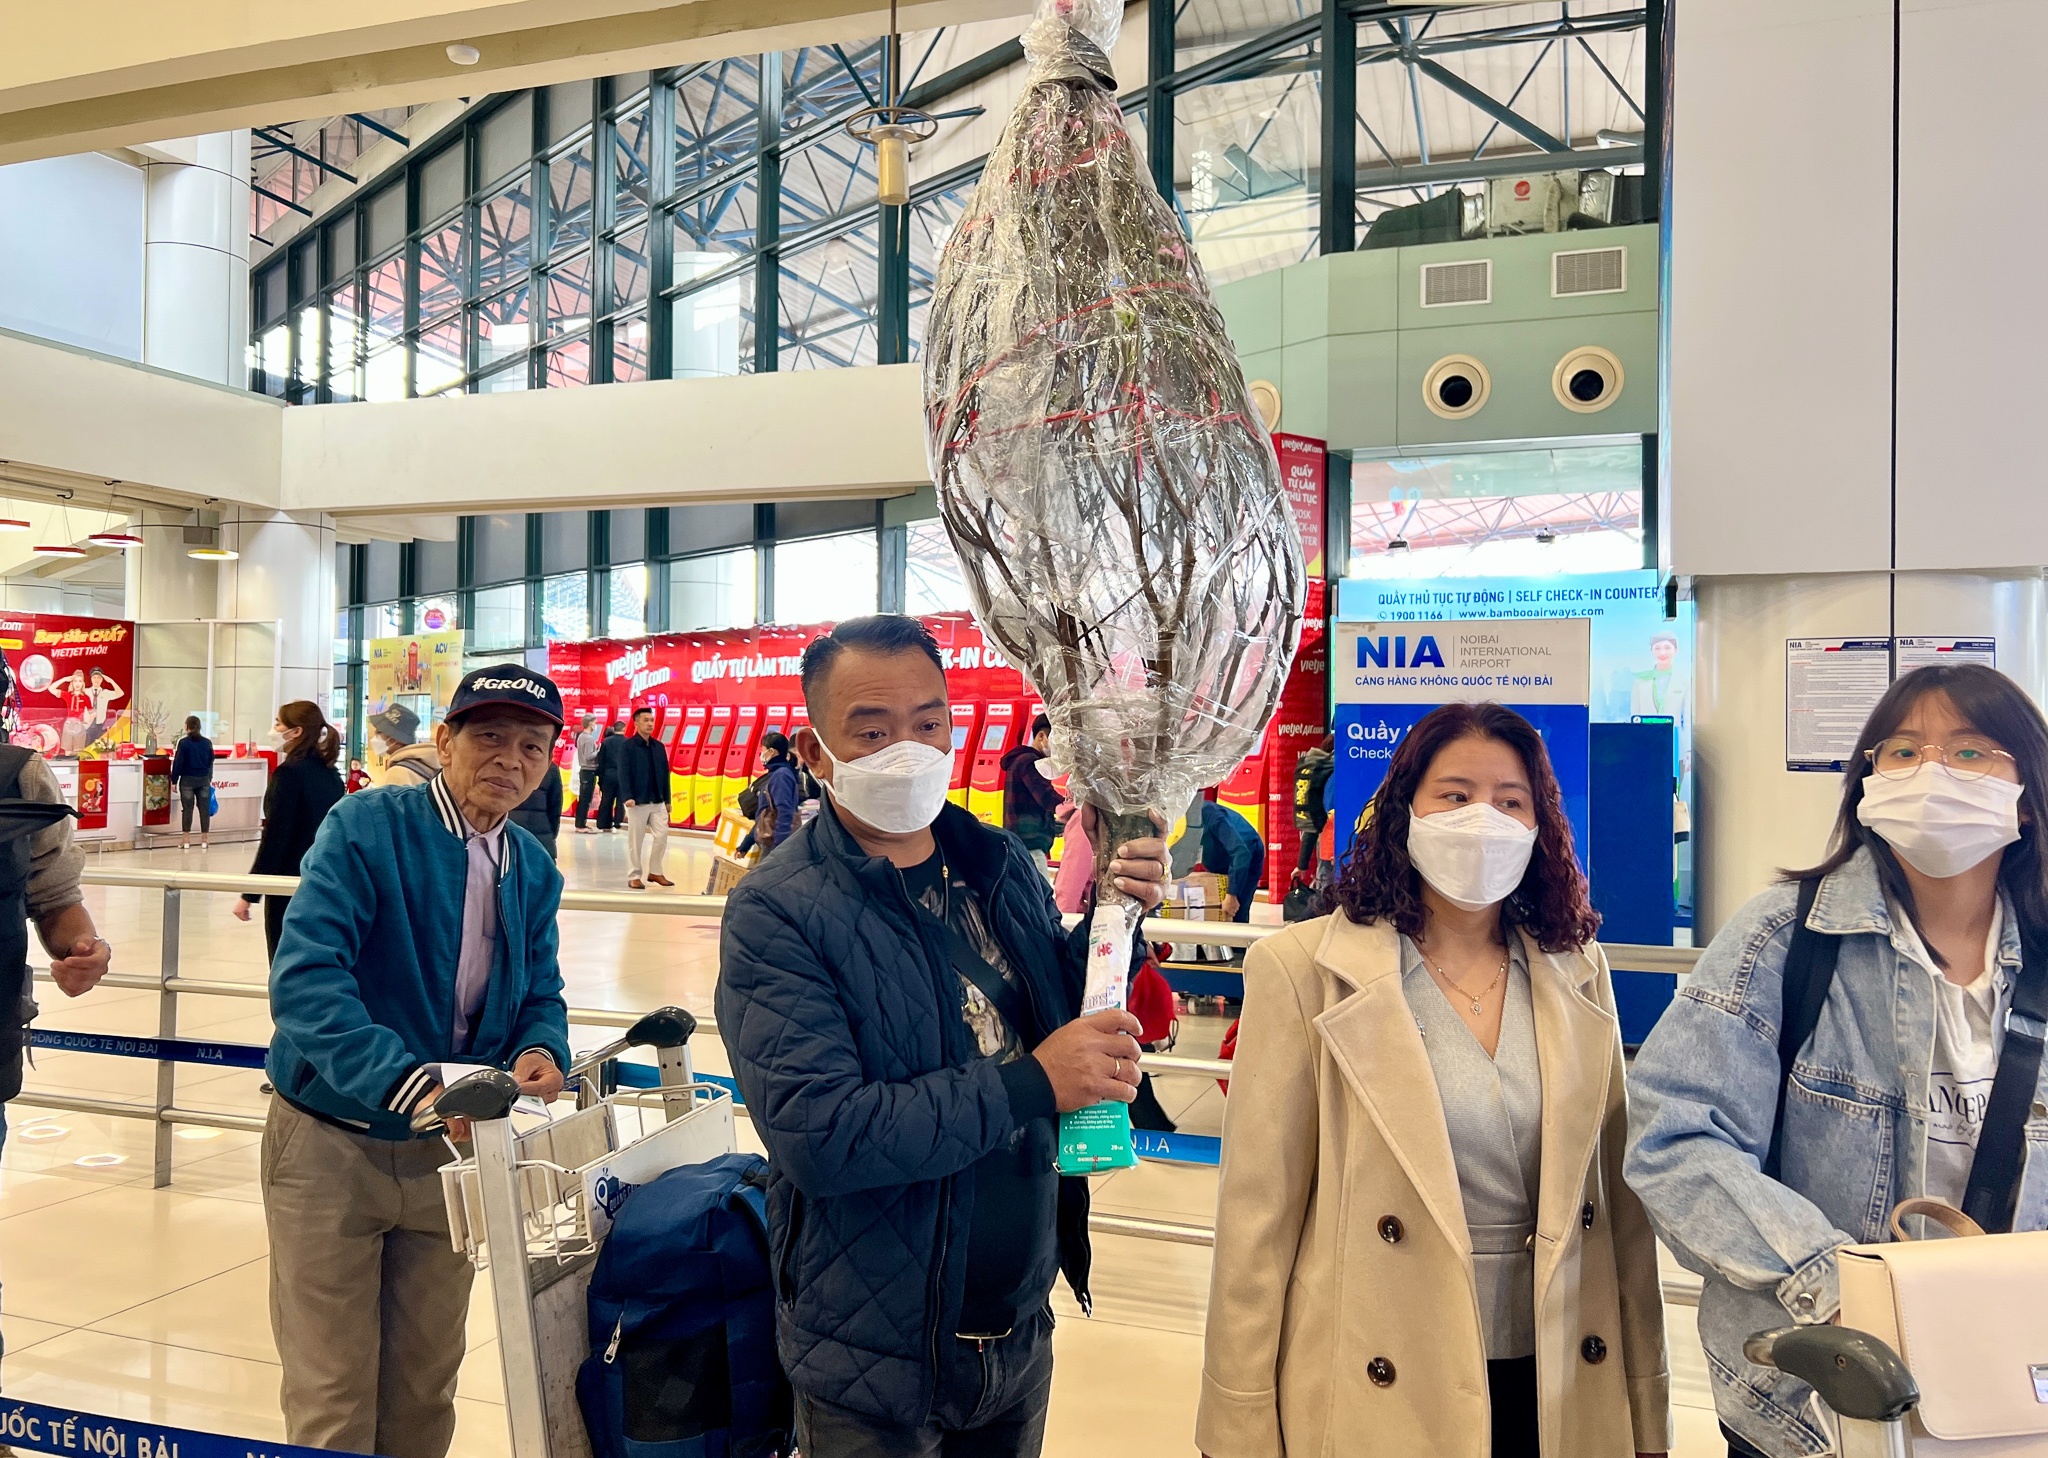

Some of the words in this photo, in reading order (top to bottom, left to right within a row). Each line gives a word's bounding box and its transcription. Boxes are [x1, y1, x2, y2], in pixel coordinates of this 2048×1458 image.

[1378, 589, 1407, 605] QUẦY
[1409, 589, 1430, 605] THỦ
[1432, 592, 1454, 607] TỤC
[1455, 591, 1472, 607] TỰ
[1473, 588, 1505, 607] ĐỘNG
[1515, 590, 1543, 602] SELF
[1545, 588, 1602, 602] CHECK-IN
[1605, 586, 1658, 600] COUNTER
[1390, 611, 1415, 620] 1900
[1419, 611, 1443, 620] 1166
[1458, 607, 1604, 619] www.bambooairways.com
[89, 624, 128, 643] CHẤT
[1460, 635, 1499, 644] NOIBAI
[51, 647, 85, 658] VIETJET
[434, 642, 448, 654] ACV
[1356, 635, 1446, 668] NIA
[1460, 646, 1552, 656] INTERNATIONAL
[748, 653, 777, 677] LÀM
[1460, 658, 1511, 668] AIRPORT
[1355, 674, 1385, 686] CẢNG
[1387, 674, 1417, 686] HÀNG
[1420, 674, 1458, 686] KHÔNG
[1534, 674, 1553, 686] BÀI
[1347, 720, 1401, 744] Quầy
[1348, 746, 1395, 759] Check-
[48, 1412, 77, 1449] TẾ
[83, 1425, 126, 1458] NỘI
